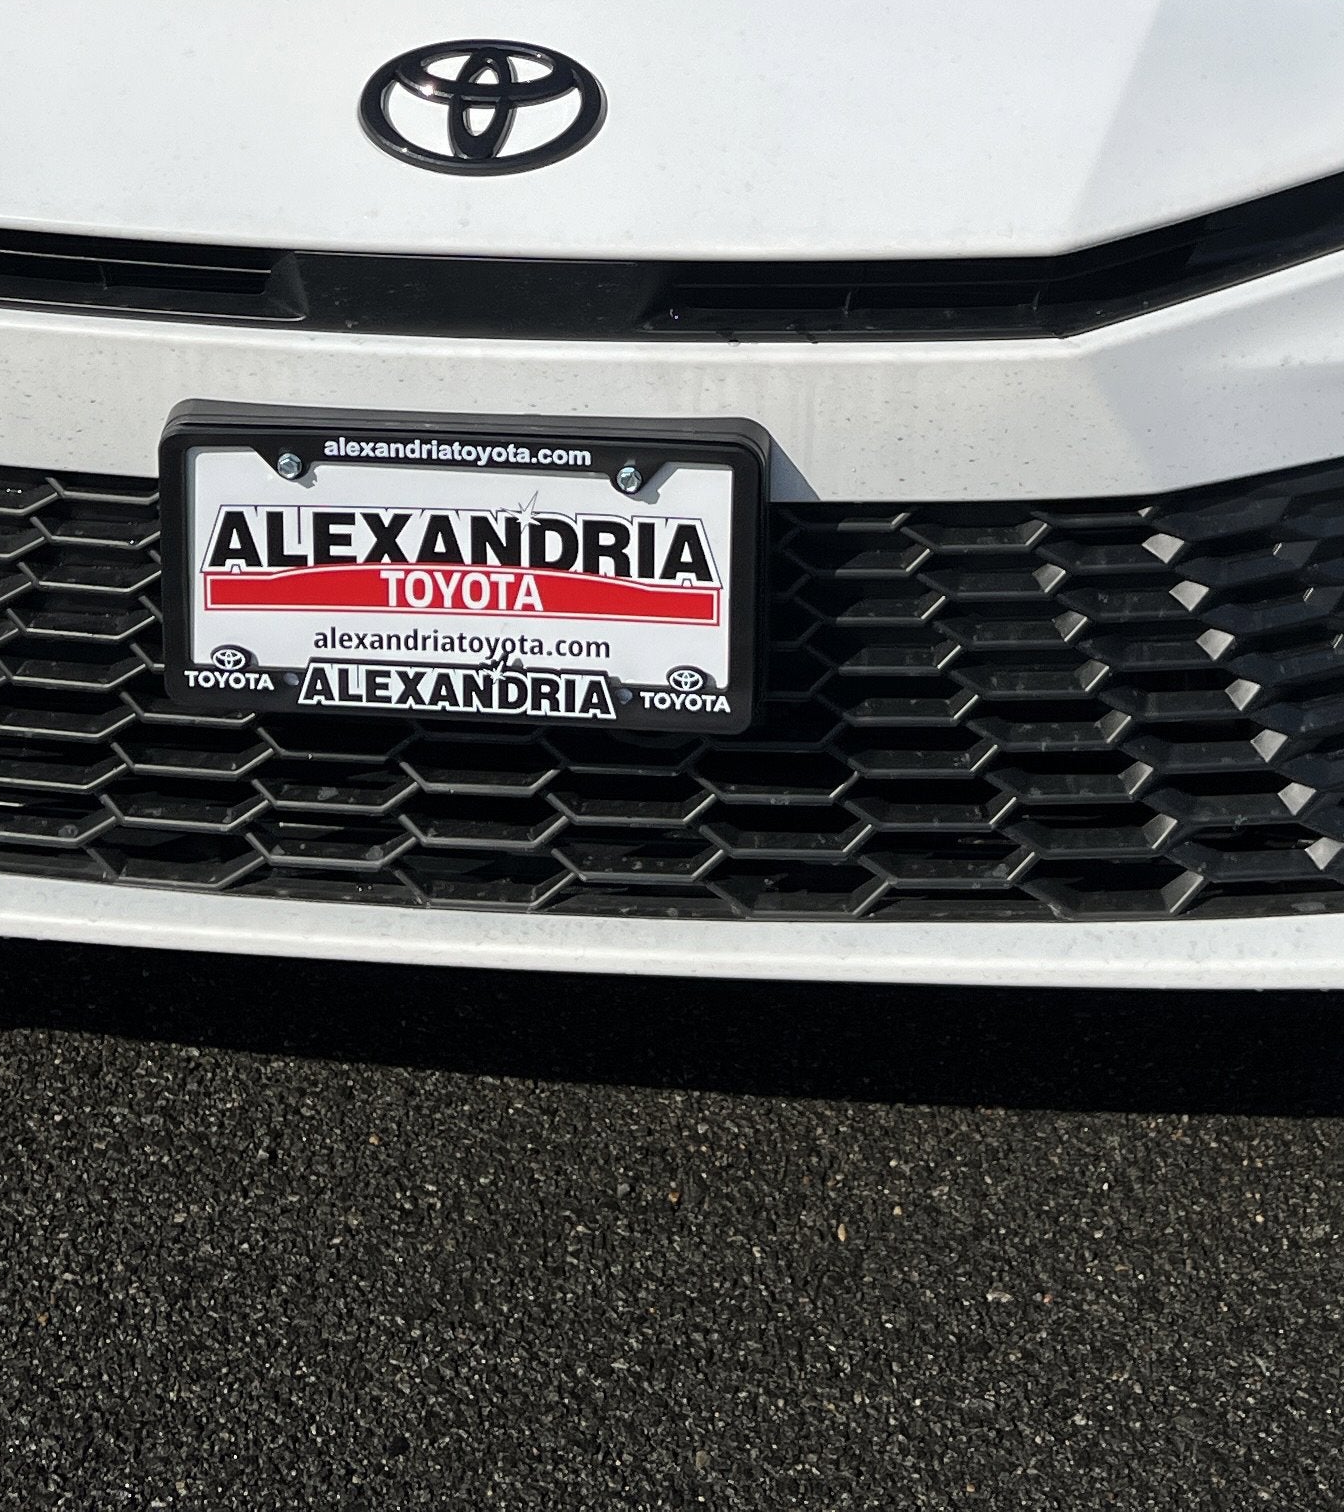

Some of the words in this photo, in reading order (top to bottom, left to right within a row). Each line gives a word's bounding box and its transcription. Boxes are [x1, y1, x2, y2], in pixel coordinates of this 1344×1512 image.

[323, 436, 593, 467] alexandriatoyota.com
[205, 508, 718, 585] ALEXANDRIA
[379, 569, 545, 612] TOYOTA
[313, 626, 611, 661] alexandriatoyota.com
[183, 669, 275, 691] TOYOTA
[299, 662, 616, 719] ALEXANDRIA
[639, 690, 732, 714] TOYOTA
